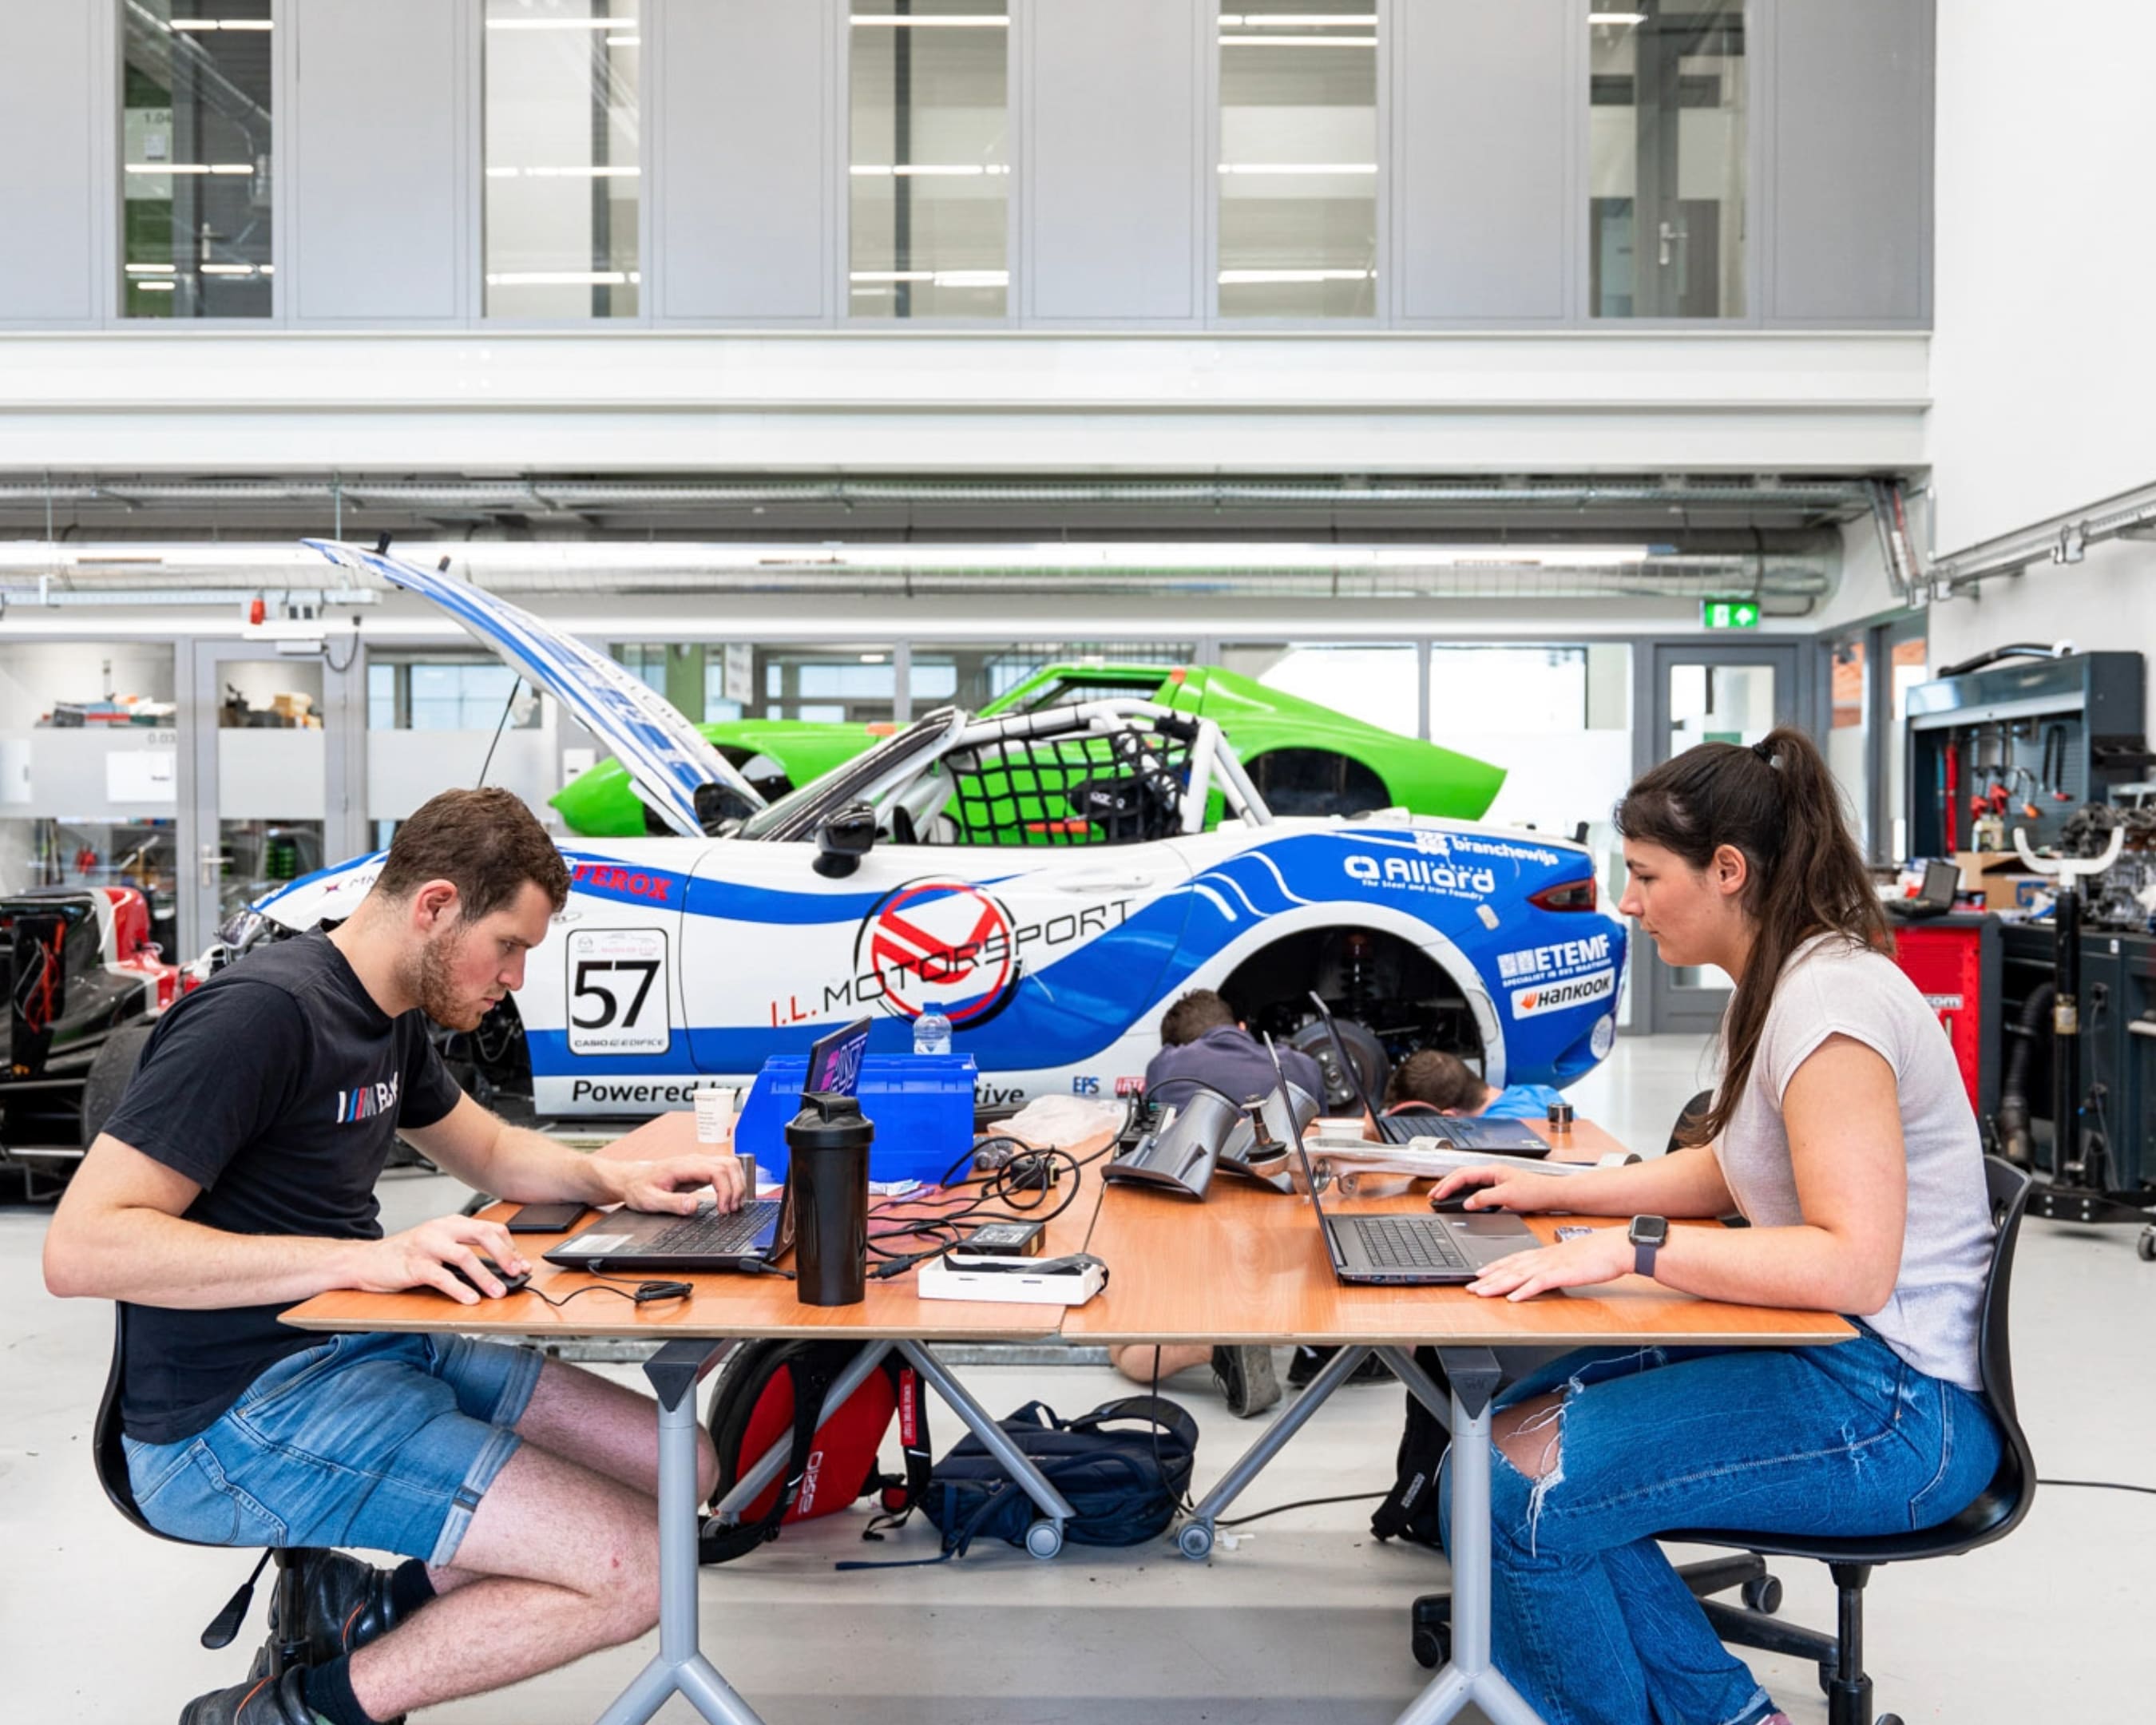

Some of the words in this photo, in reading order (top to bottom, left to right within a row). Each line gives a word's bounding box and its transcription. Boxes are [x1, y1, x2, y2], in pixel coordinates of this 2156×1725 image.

[1451, 836, 1560, 866] branchewijs
[573, 864, 672, 901] FEROX
[1382, 879, 1405, 890] Steel
[1384, 857, 1496, 894] Allard
[771, 995, 818, 1028] I.L.
[824, 898, 1135, 1013] MOTORSPORT
[572, 960, 661, 1029] 57
[573, 1080, 700, 1101] Powered
